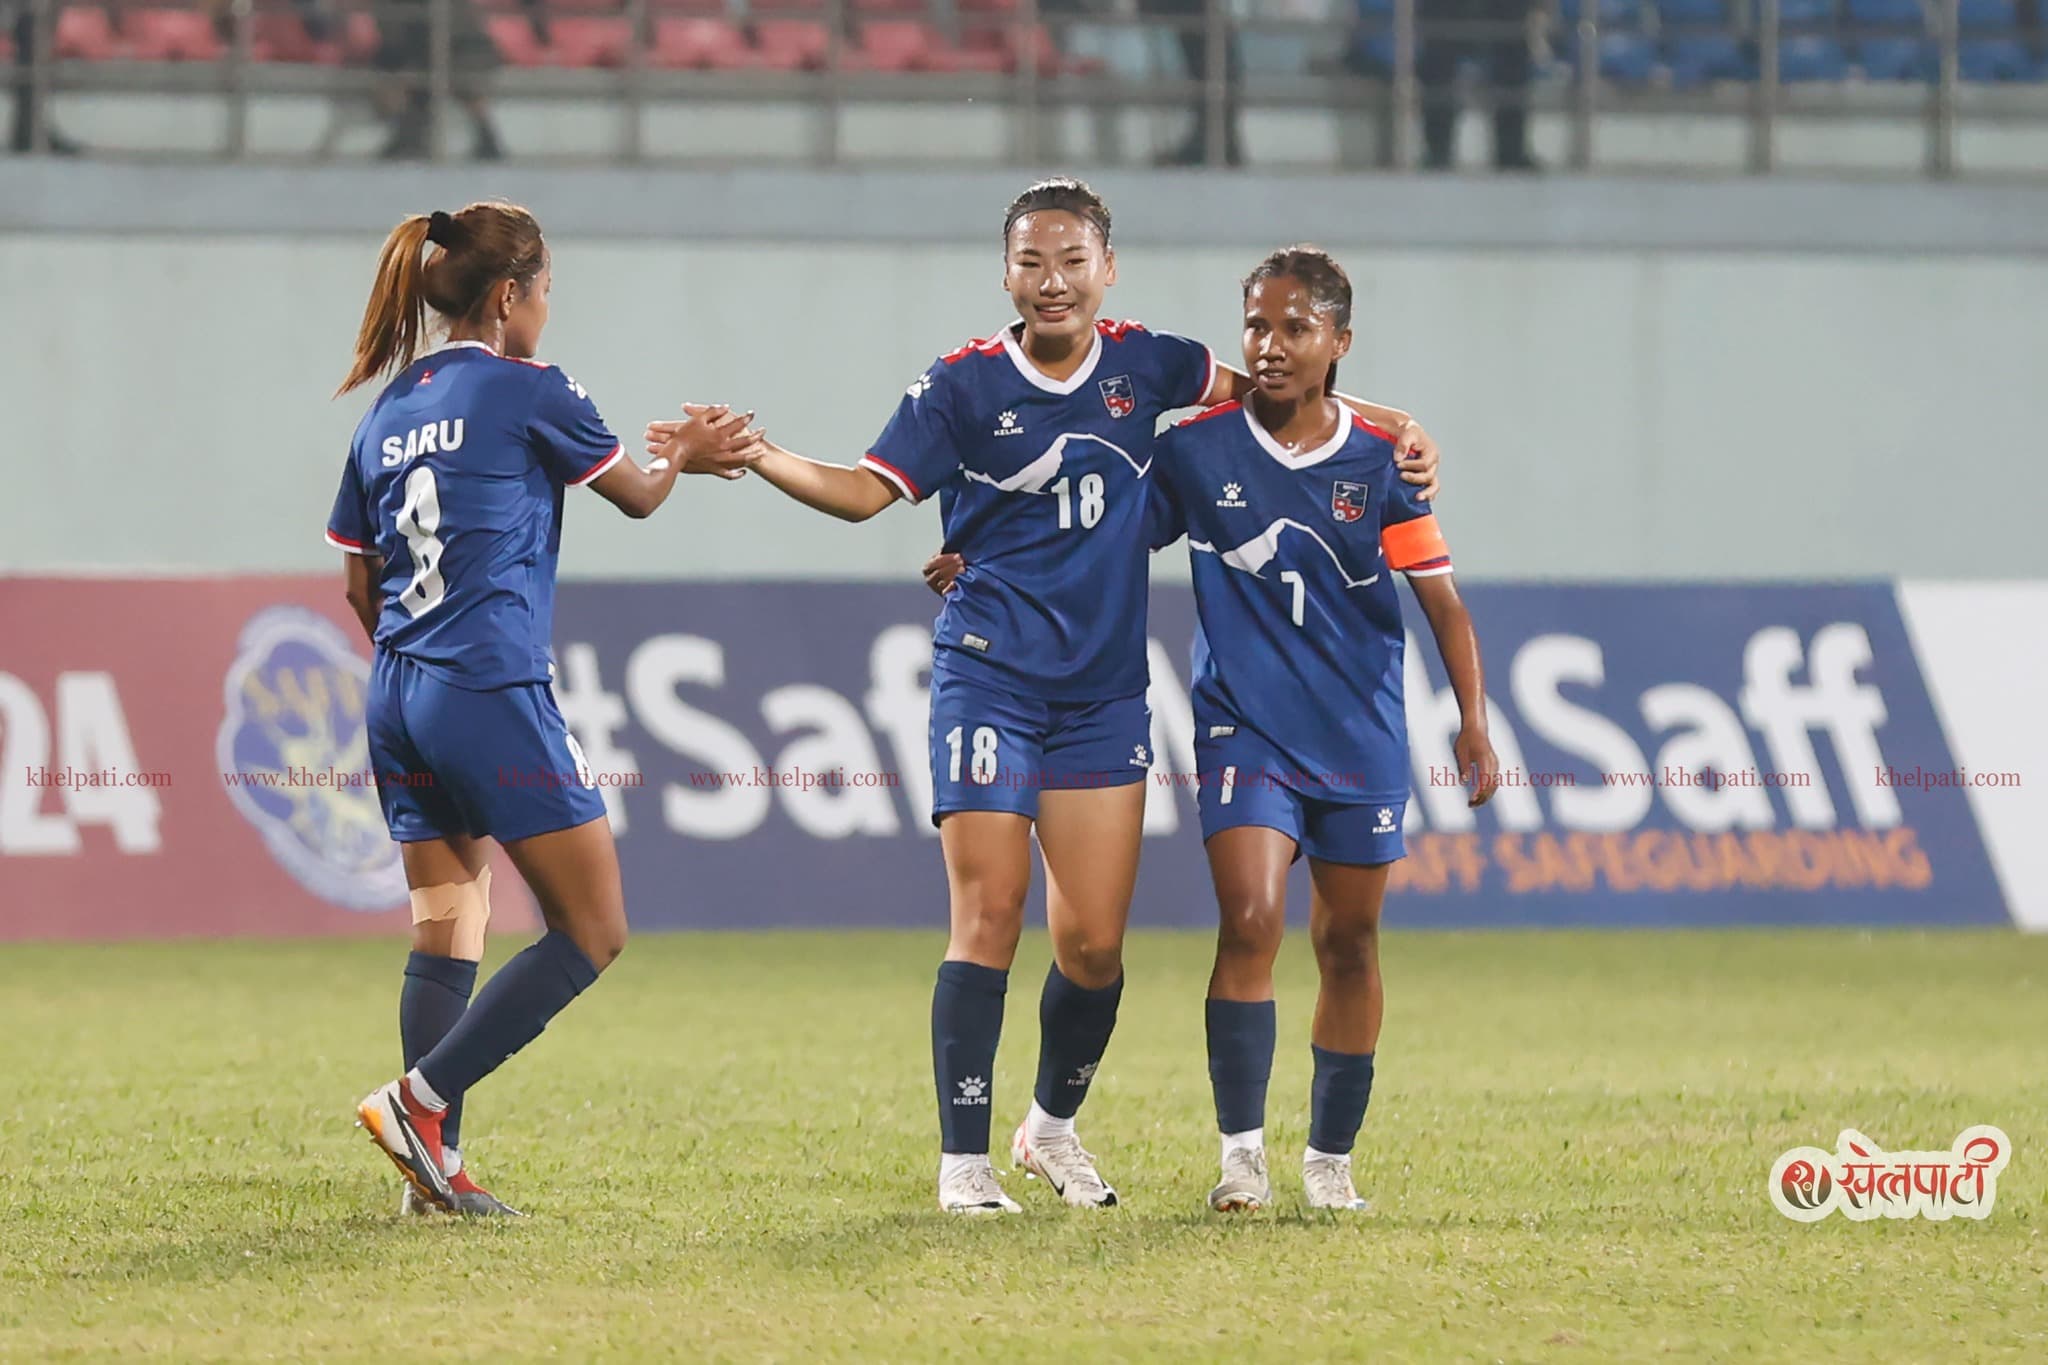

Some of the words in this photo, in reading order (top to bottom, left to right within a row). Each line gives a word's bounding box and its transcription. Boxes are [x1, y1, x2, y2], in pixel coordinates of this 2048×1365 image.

[382, 418, 464, 467] SARU
[994, 426, 1024, 437] KELME
[1051, 473, 1105, 529] 18
[1216, 499, 1248, 508] KELME
[396, 466, 445, 619] 8
[1280, 570, 1305, 627] 7
[946, 726, 998, 784] 18
[1493, 828, 1933, 892] SAFEGUARDING
